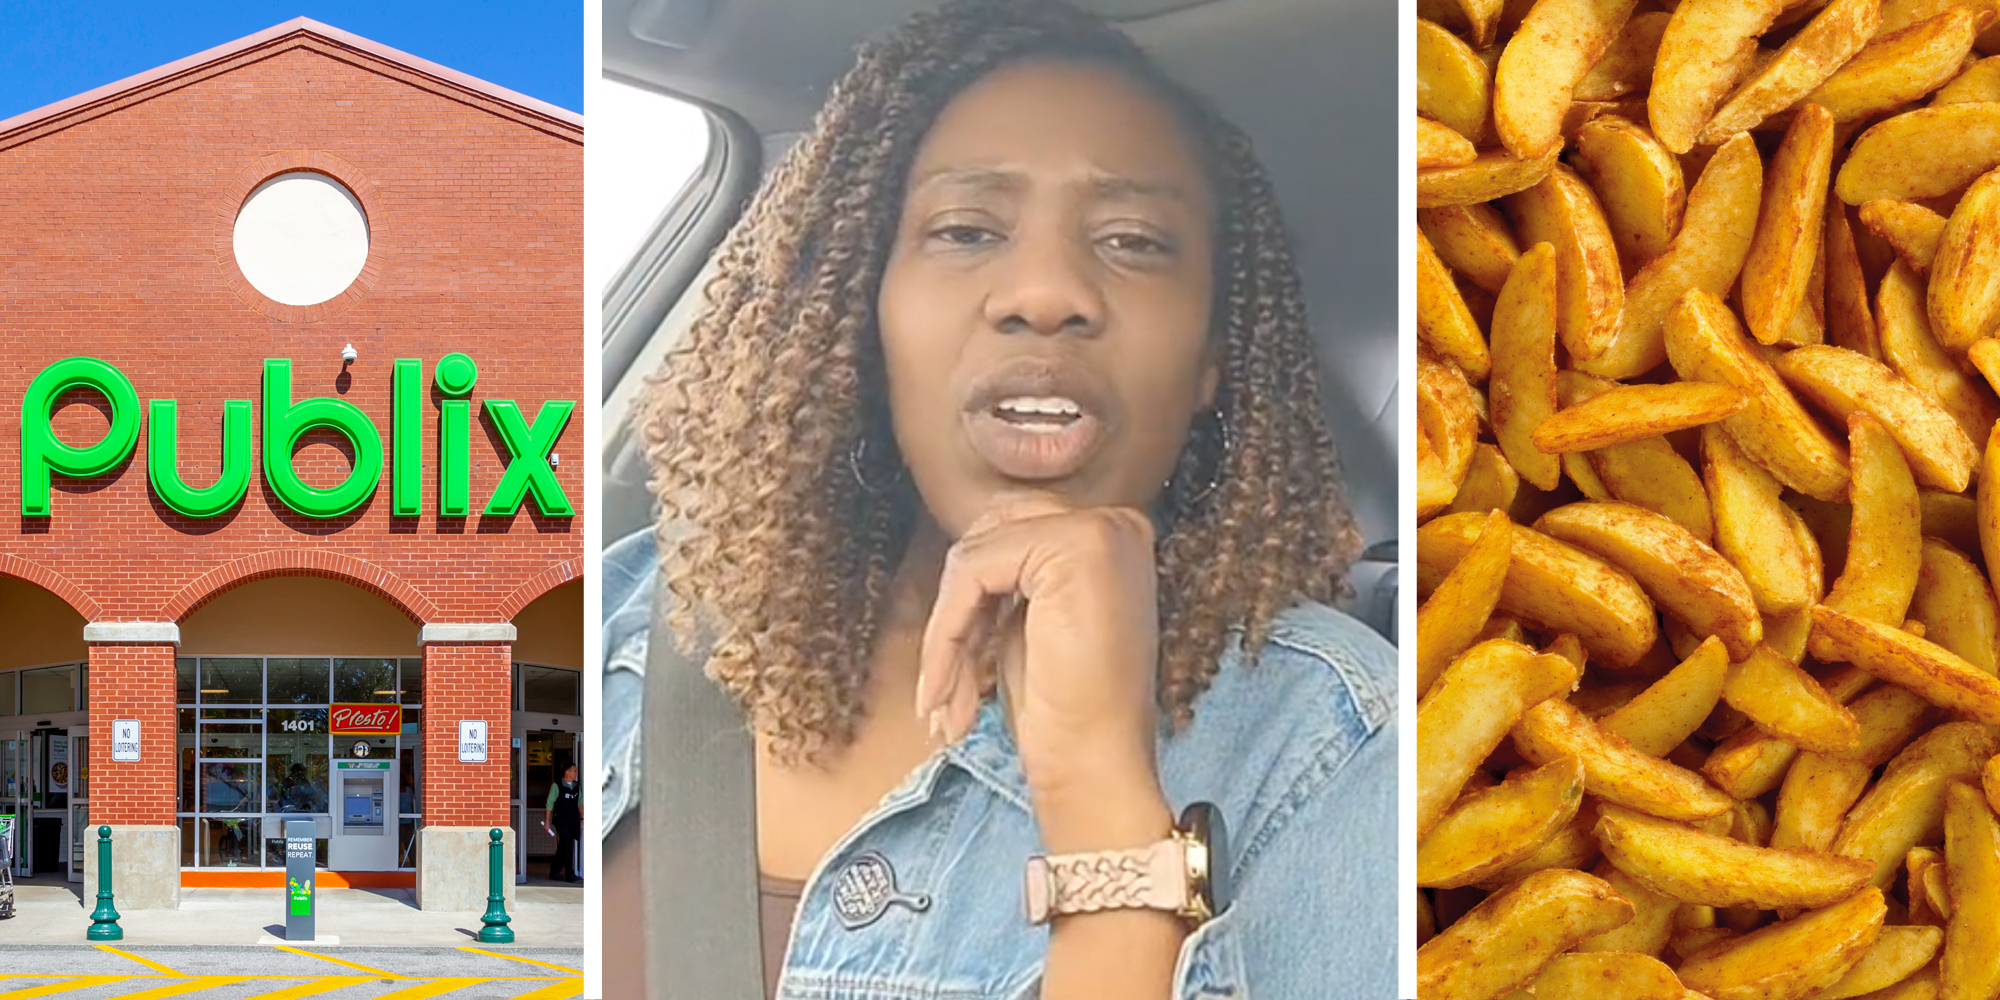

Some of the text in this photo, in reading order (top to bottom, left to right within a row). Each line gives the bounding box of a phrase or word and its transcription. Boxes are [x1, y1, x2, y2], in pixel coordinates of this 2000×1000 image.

[21, 353, 576, 517] Publix
[332, 708, 399, 730] Presto!
[281, 720, 315, 731] 1401
[122, 728, 131, 738] NO
[469, 729, 478, 738] NO
[115, 742, 138, 753] LOITERING
[462, 743, 484, 753] LOITERING
